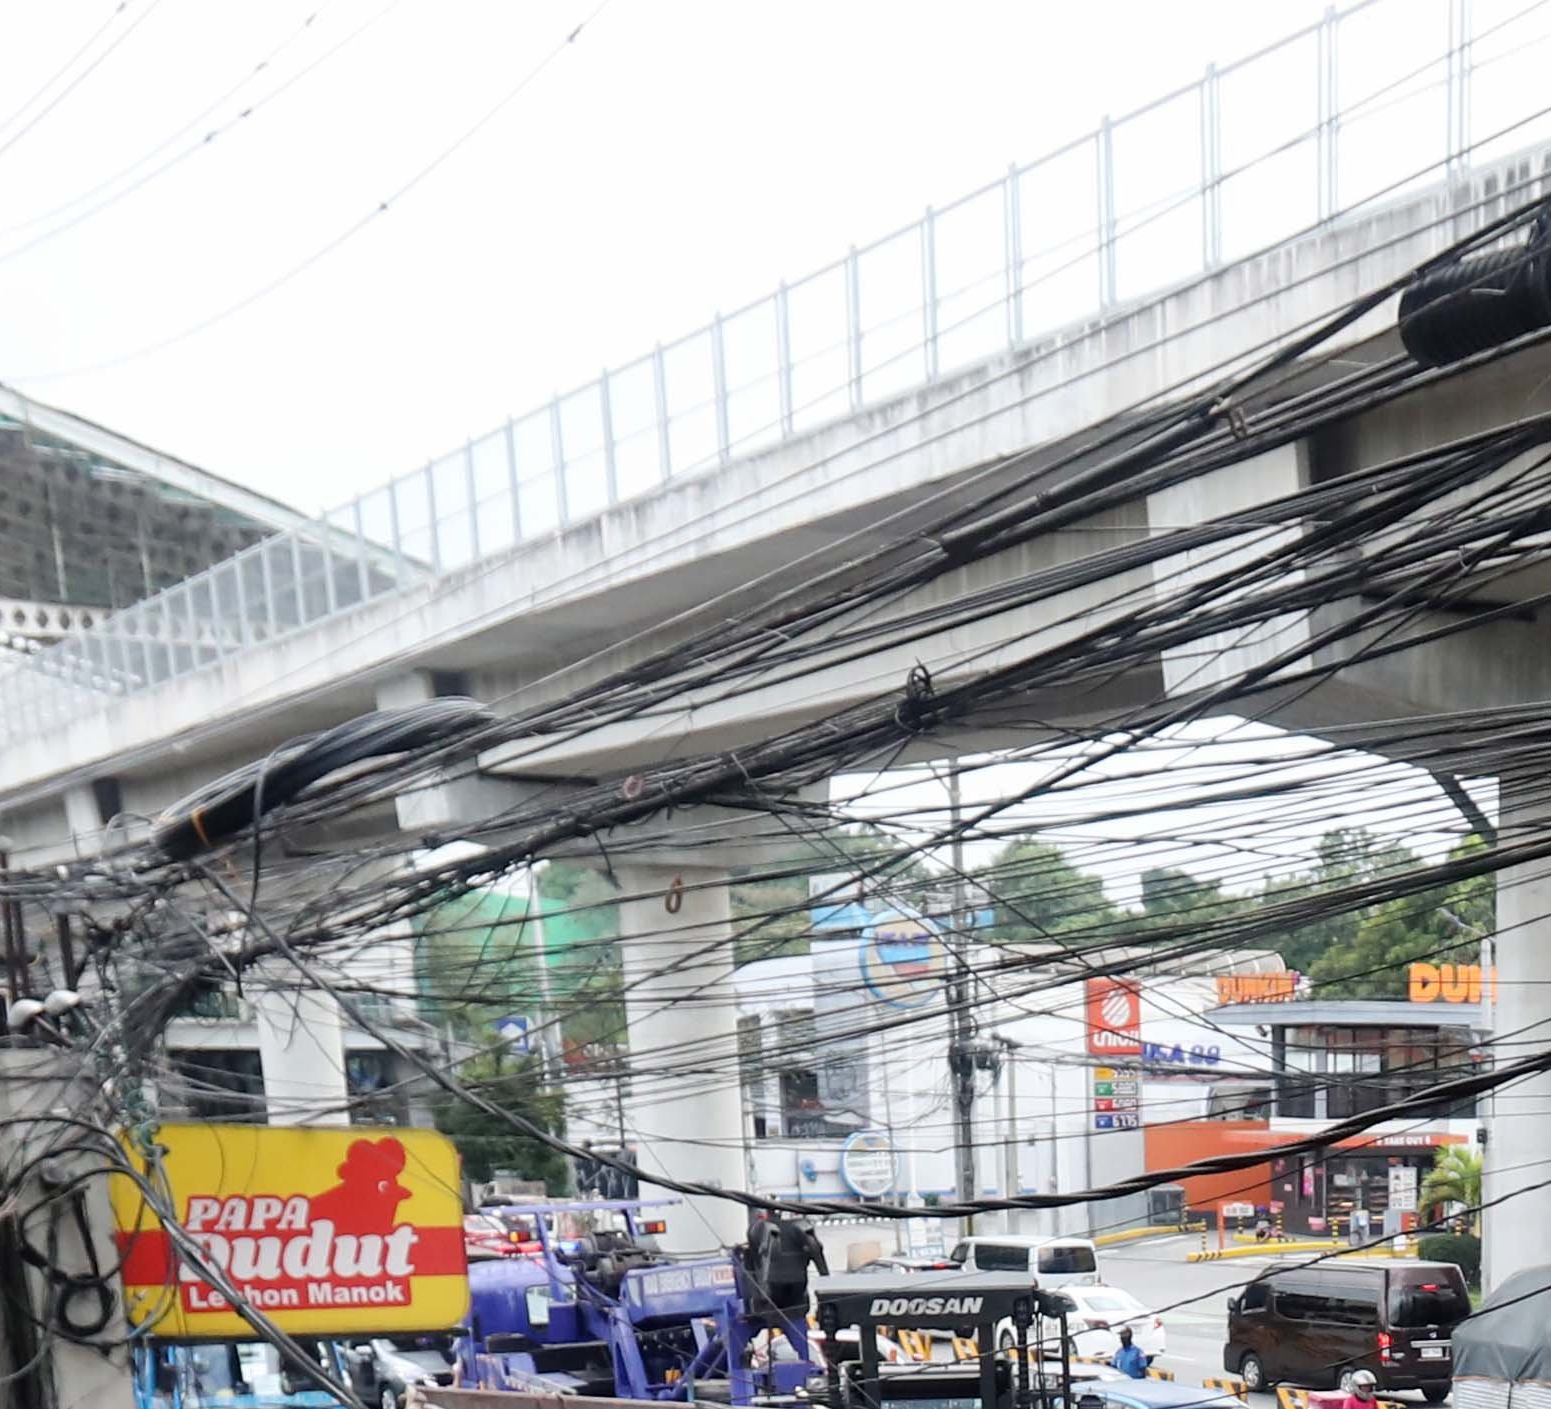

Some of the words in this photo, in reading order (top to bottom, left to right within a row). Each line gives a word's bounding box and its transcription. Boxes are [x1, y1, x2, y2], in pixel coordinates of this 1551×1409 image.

[187, 1197, 310, 1231] PAPA
[180, 1219, 419, 1282] Dudut
[190, 1285, 300, 1307] Lehon
[308, 1281, 404, 1306] Manok
[870, 1297, 984, 1316] DOOSAN
